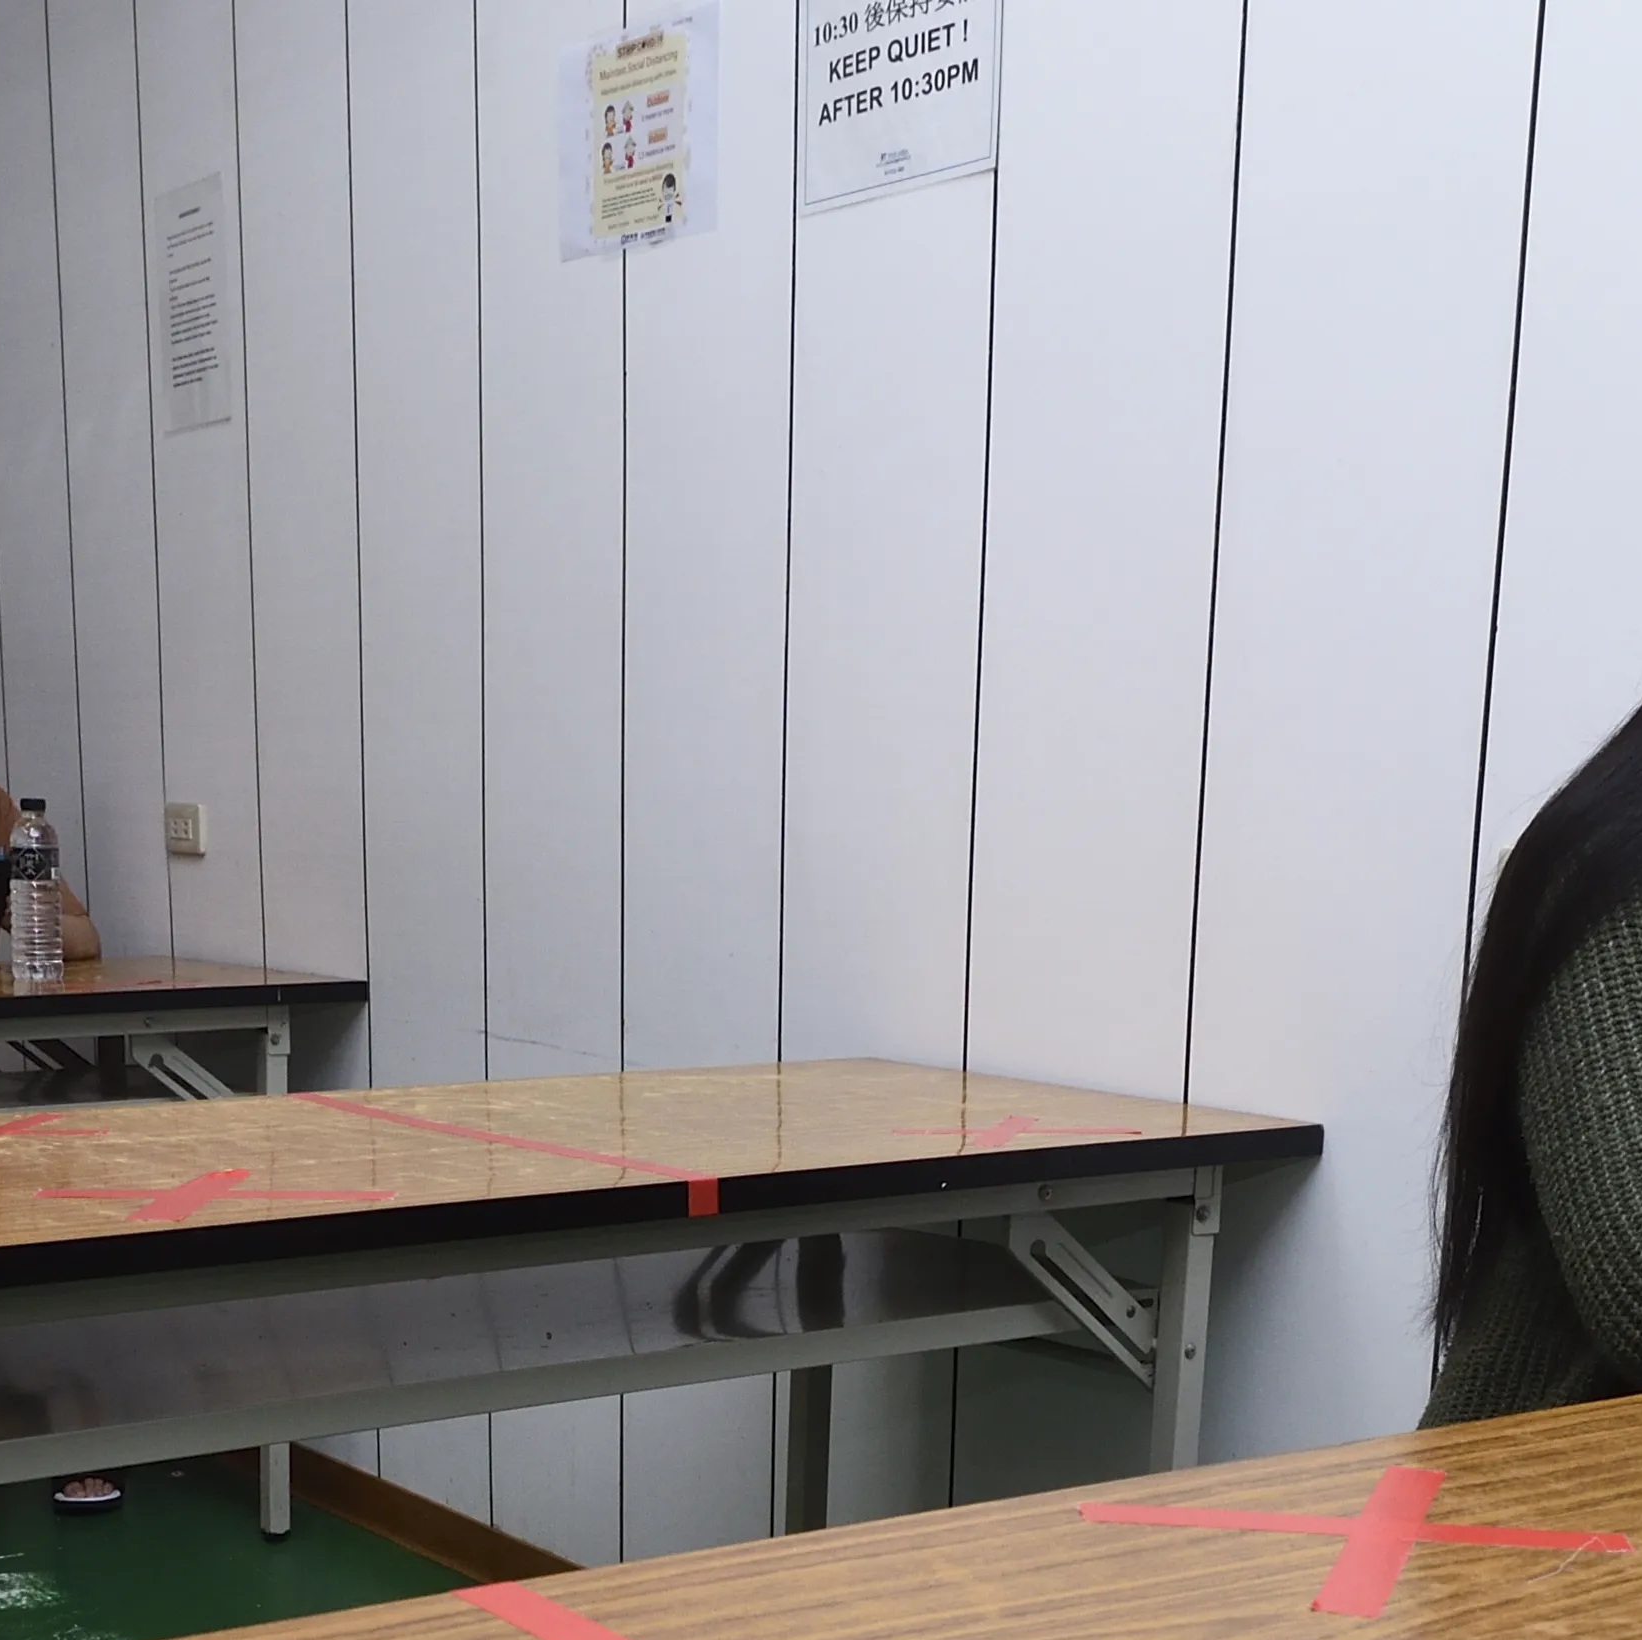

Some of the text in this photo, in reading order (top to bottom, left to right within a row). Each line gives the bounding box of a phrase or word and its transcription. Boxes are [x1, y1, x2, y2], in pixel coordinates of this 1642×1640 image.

[814, 0, 972, 48] 10:30 後保持
[829, 46, 880, 83] KEEP
[887, 23, 955, 63] QUIET
[818, 58, 978, 126] AFTER 10:30PM
